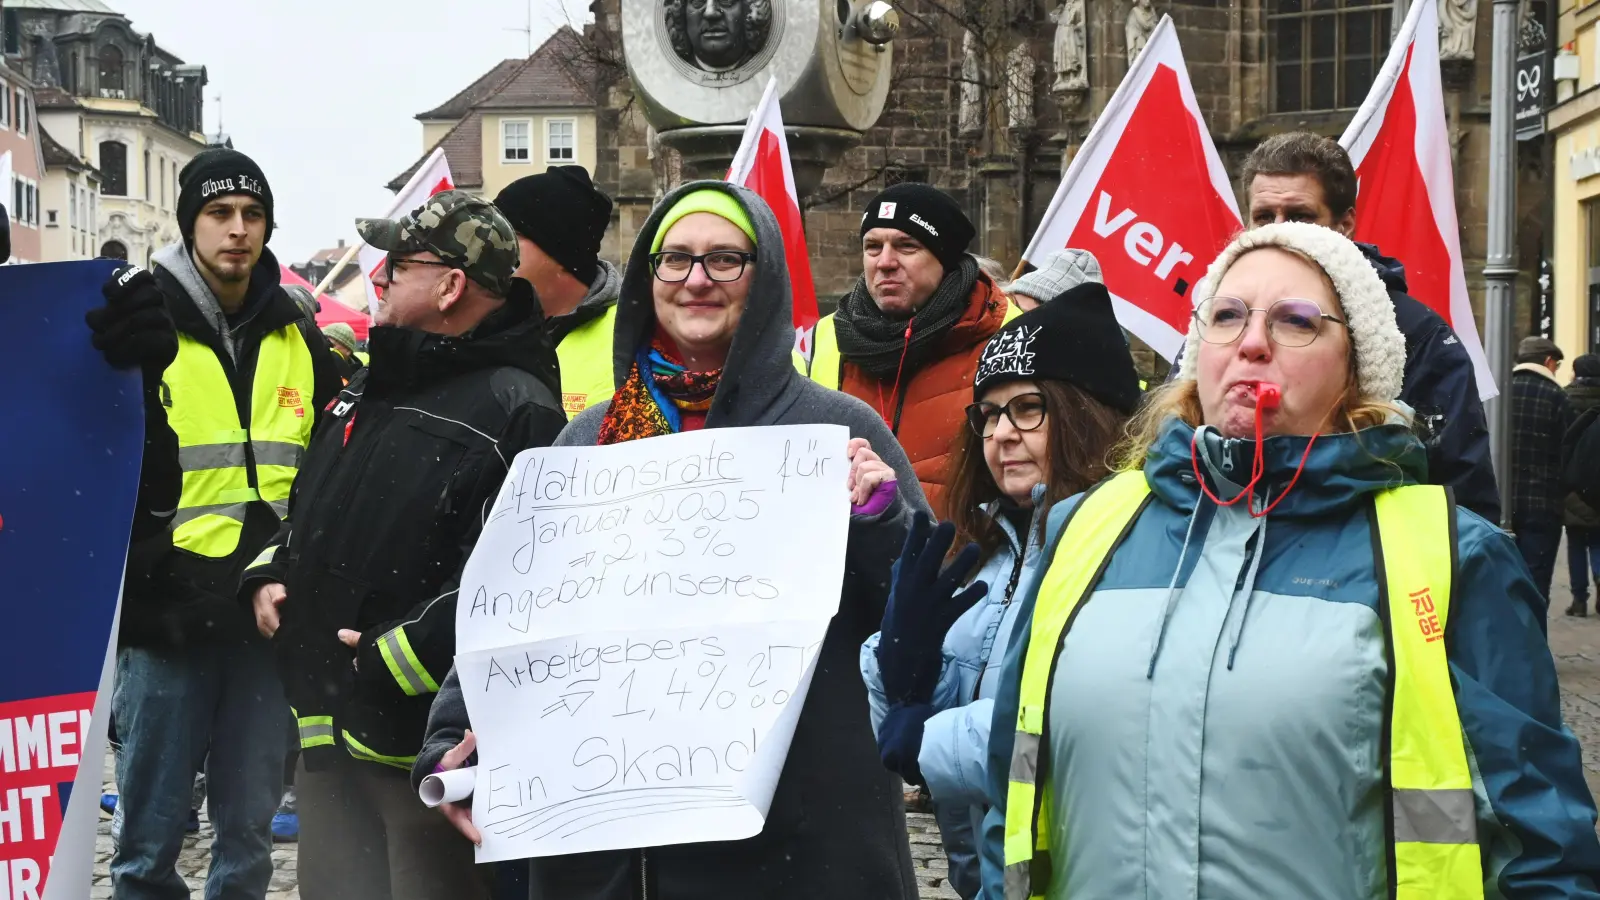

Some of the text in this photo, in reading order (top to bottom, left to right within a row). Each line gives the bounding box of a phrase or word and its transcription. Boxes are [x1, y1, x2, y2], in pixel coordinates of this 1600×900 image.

[202, 174, 262, 197] Thug Life
[1092, 190, 1206, 306] ver.
[501, 438, 831, 513] nflationsrate für
[512, 490, 765, 574] Januar 2025
[470, 568, 780, 634] Angebot unseres
[485, 636, 726, 692] Arbeitgebers
[487, 728, 757, 813] Ein Skand
